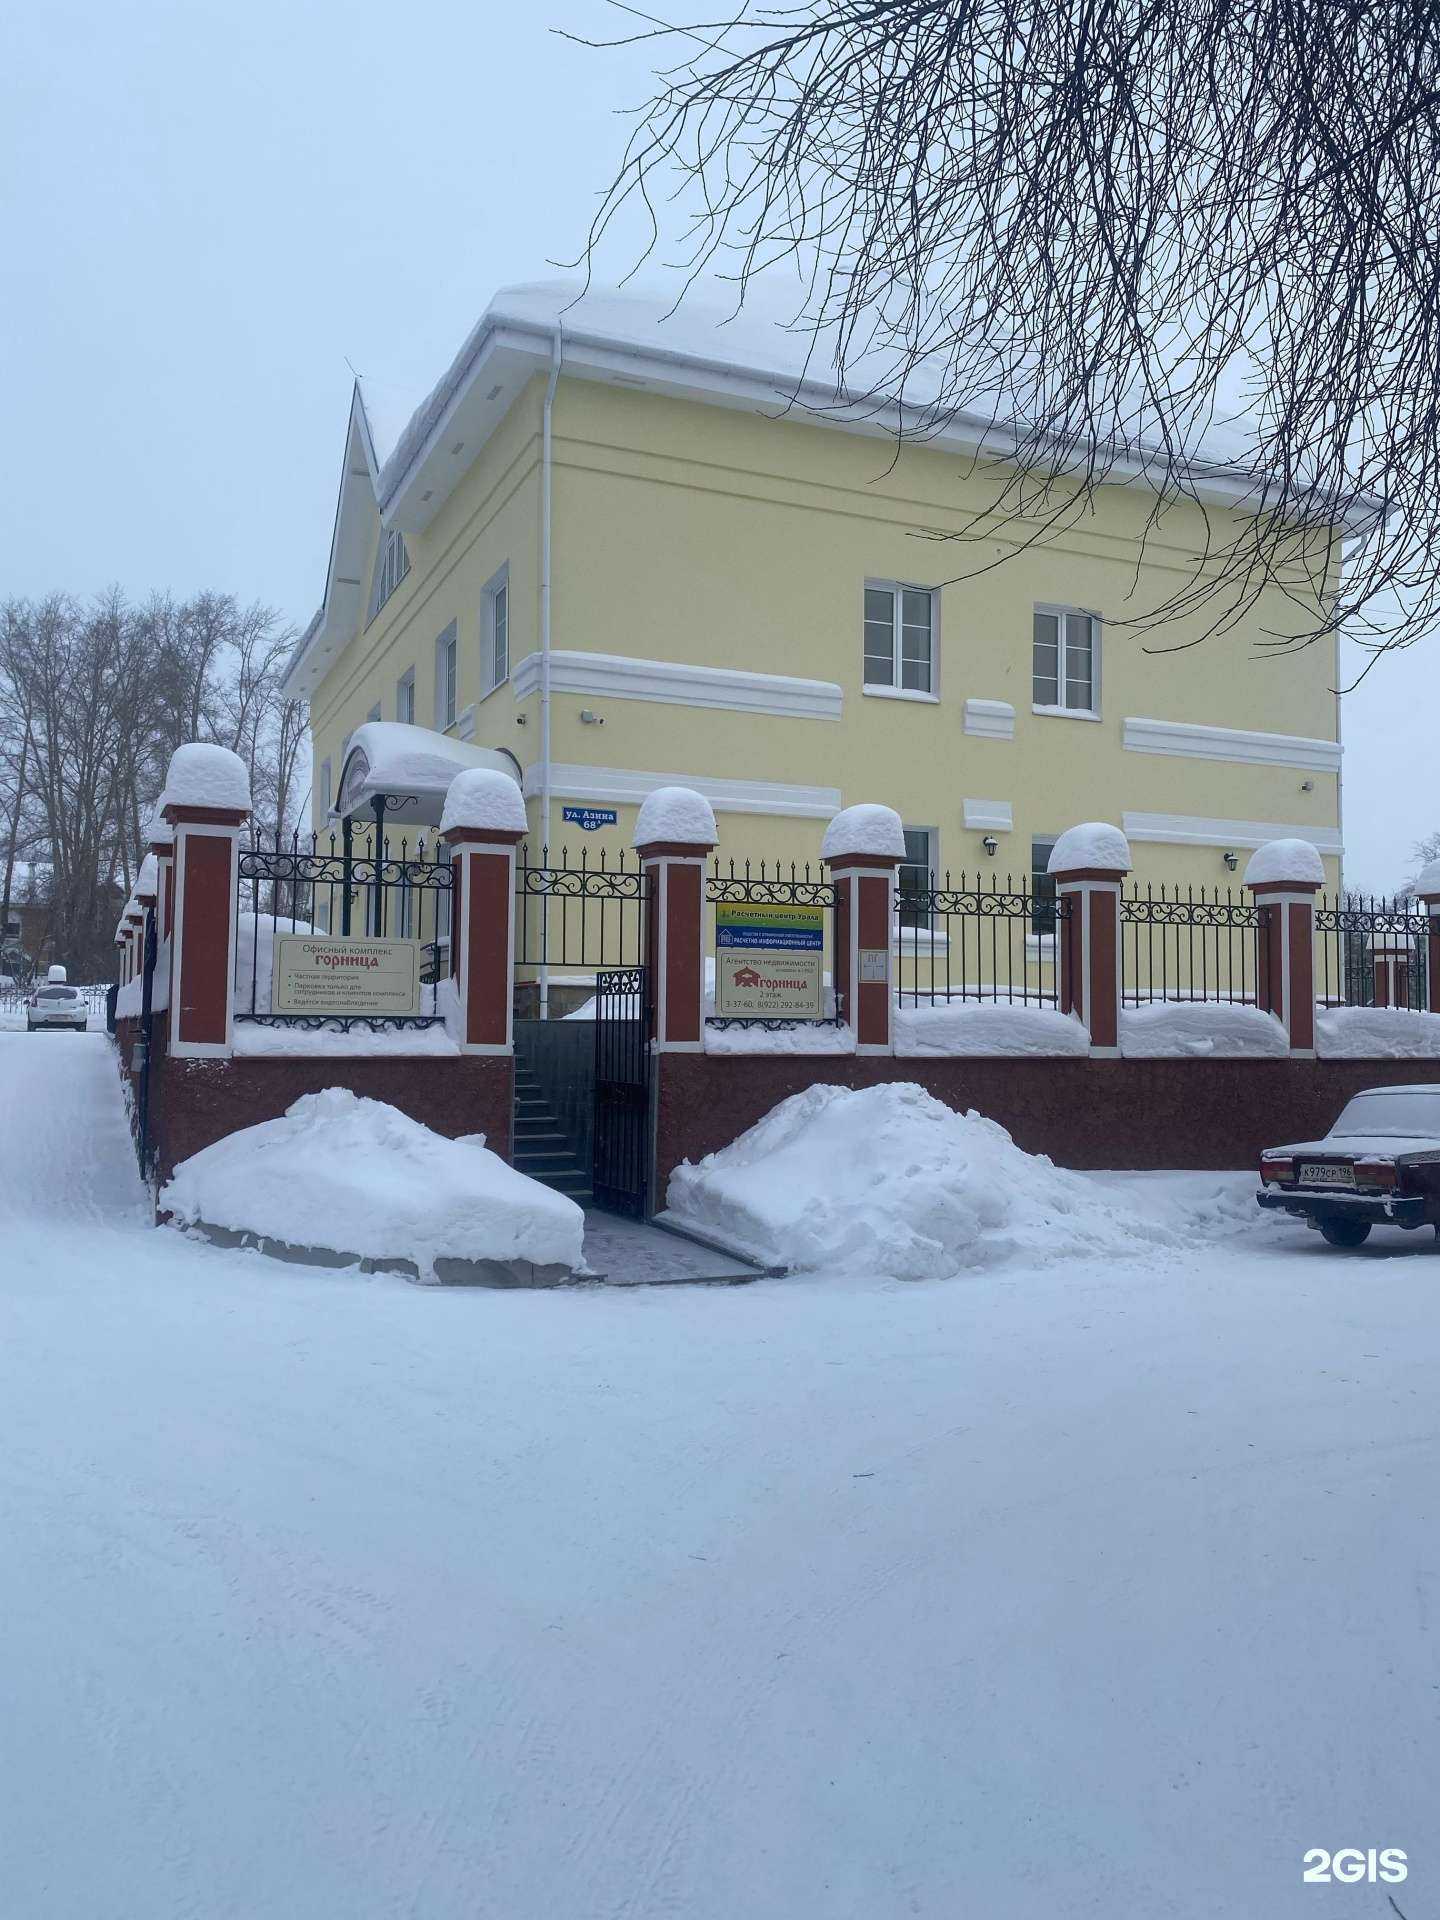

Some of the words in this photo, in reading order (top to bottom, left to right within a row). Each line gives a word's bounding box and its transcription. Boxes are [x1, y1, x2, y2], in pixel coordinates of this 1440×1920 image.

[566, 811, 580, 820] ул.
[583, 810, 614, 821] Азина
[775, 913, 796, 921] центр
[302, 944, 347, 955] Офисный
[349, 947, 393, 956] комплекс
[726, 957, 762, 966] Агентство
[763, 959, 816, 968] недвижимости
